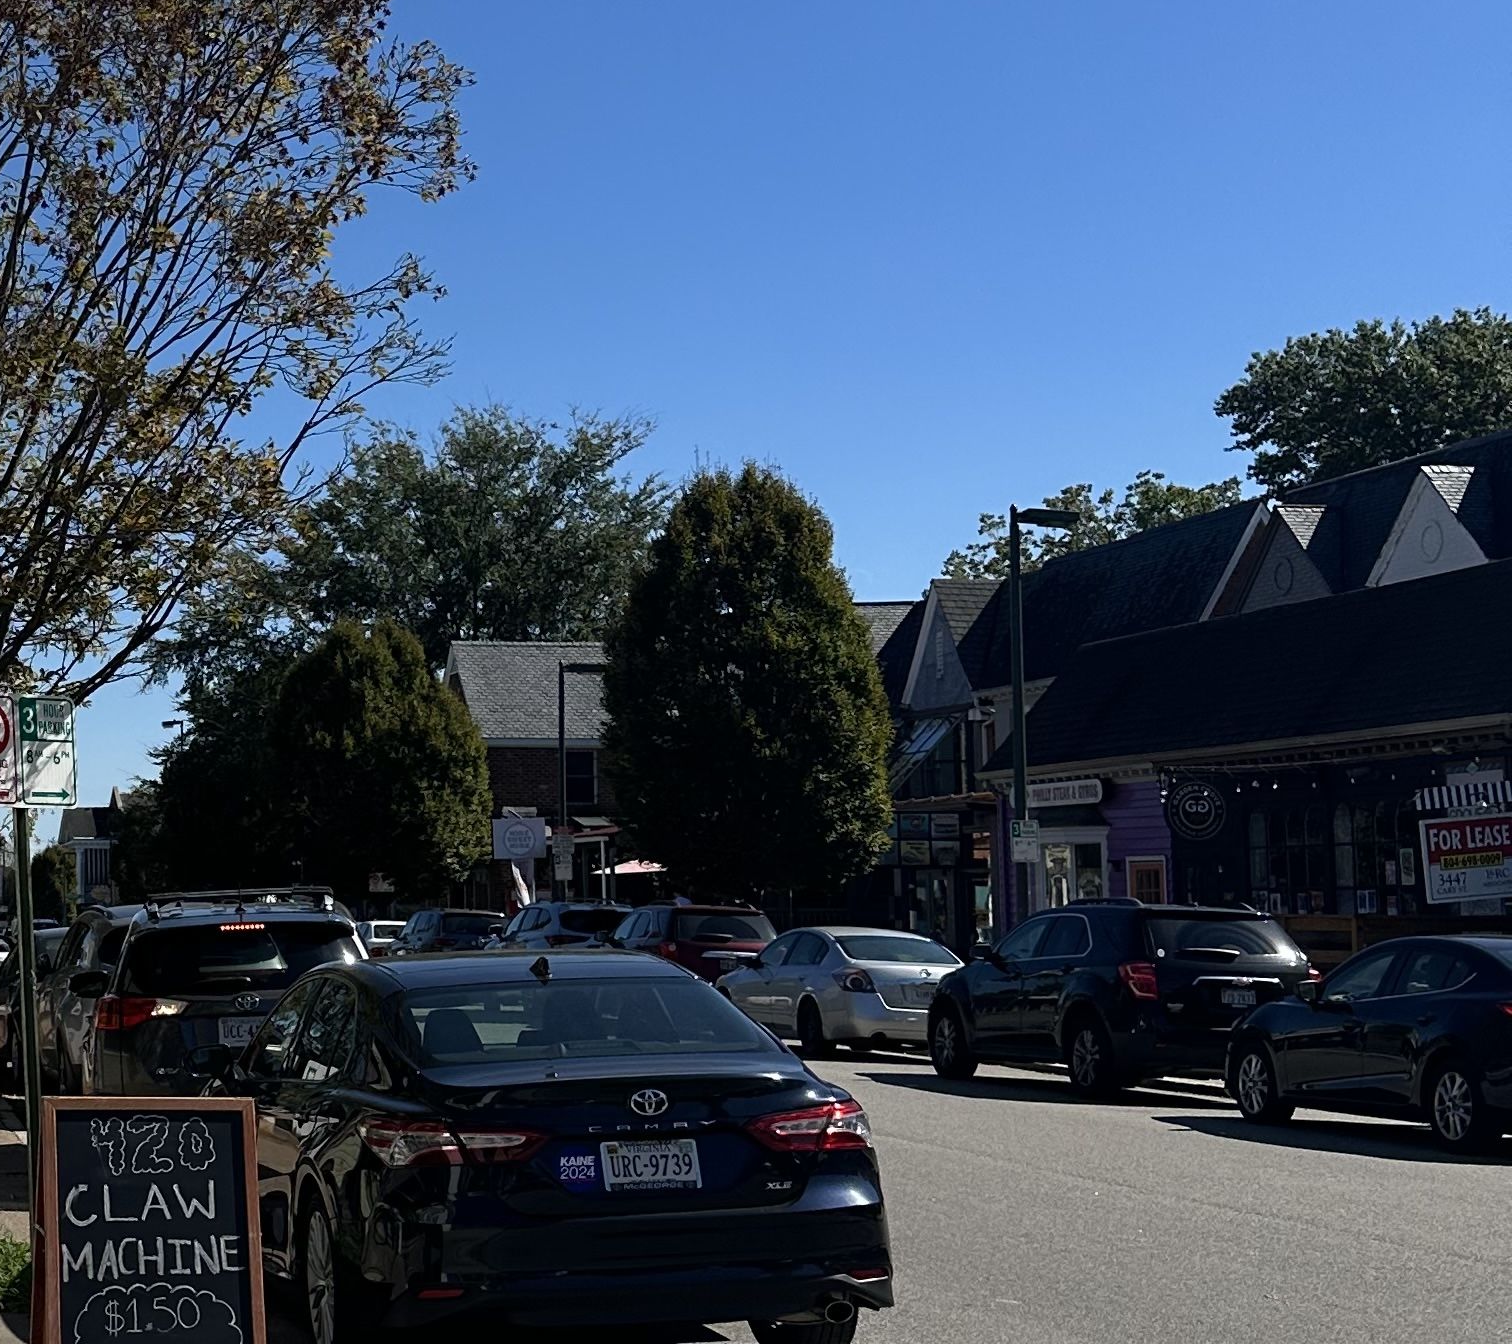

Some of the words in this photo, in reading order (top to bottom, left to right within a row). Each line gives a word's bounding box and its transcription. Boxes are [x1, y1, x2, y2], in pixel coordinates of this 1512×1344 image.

[22, 706, 35, 734] 3
[43, 703, 65, 718] HOUR
[38, 720, 71, 736] PARKING
[1429, 828, 1463, 852] FOR
[1465, 823, 1512, 849] LEASE
[1439, 871, 1467, 887] 3447
[588, 1120, 717, 1133] CAMRY
[90, 1114, 217, 1177] 420
[559, 1155, 596, 1167] KAINE
[559, 1166, 596, 1180] 2024
[609, 1153, 693, 1178] URC-9739
[64, 1179, 217, 1227] CLAW
[60, 1234, 247, 1282] MACHINE
[104, 1297, 201, 1337] $1.50
